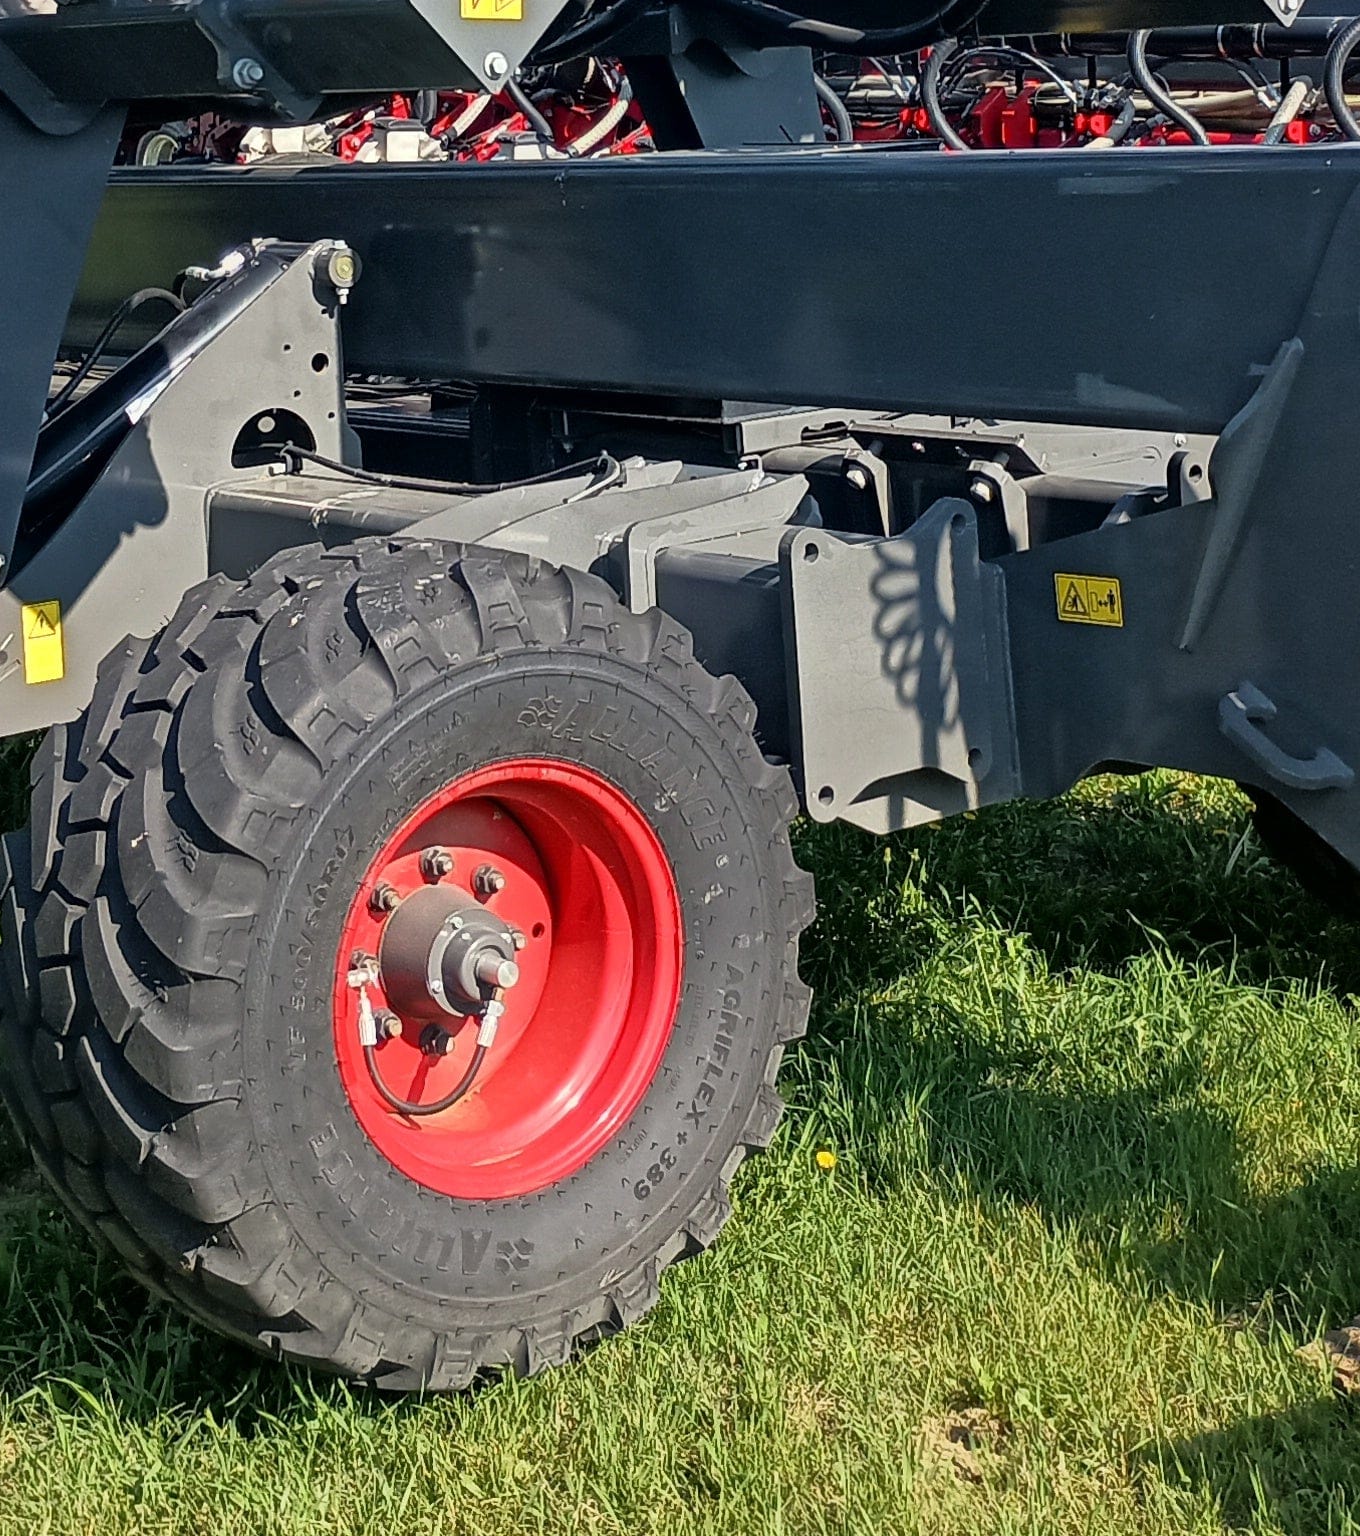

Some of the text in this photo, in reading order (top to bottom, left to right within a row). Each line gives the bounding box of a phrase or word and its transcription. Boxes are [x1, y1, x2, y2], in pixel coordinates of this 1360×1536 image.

[551, 695, 728, 852] ALLIANCE
[685, 963, 745, 1131] AGRIFLEX
[308, 1121, 493, 1276] ALLIANCE
[633, 1146, 677, 1201] 389
